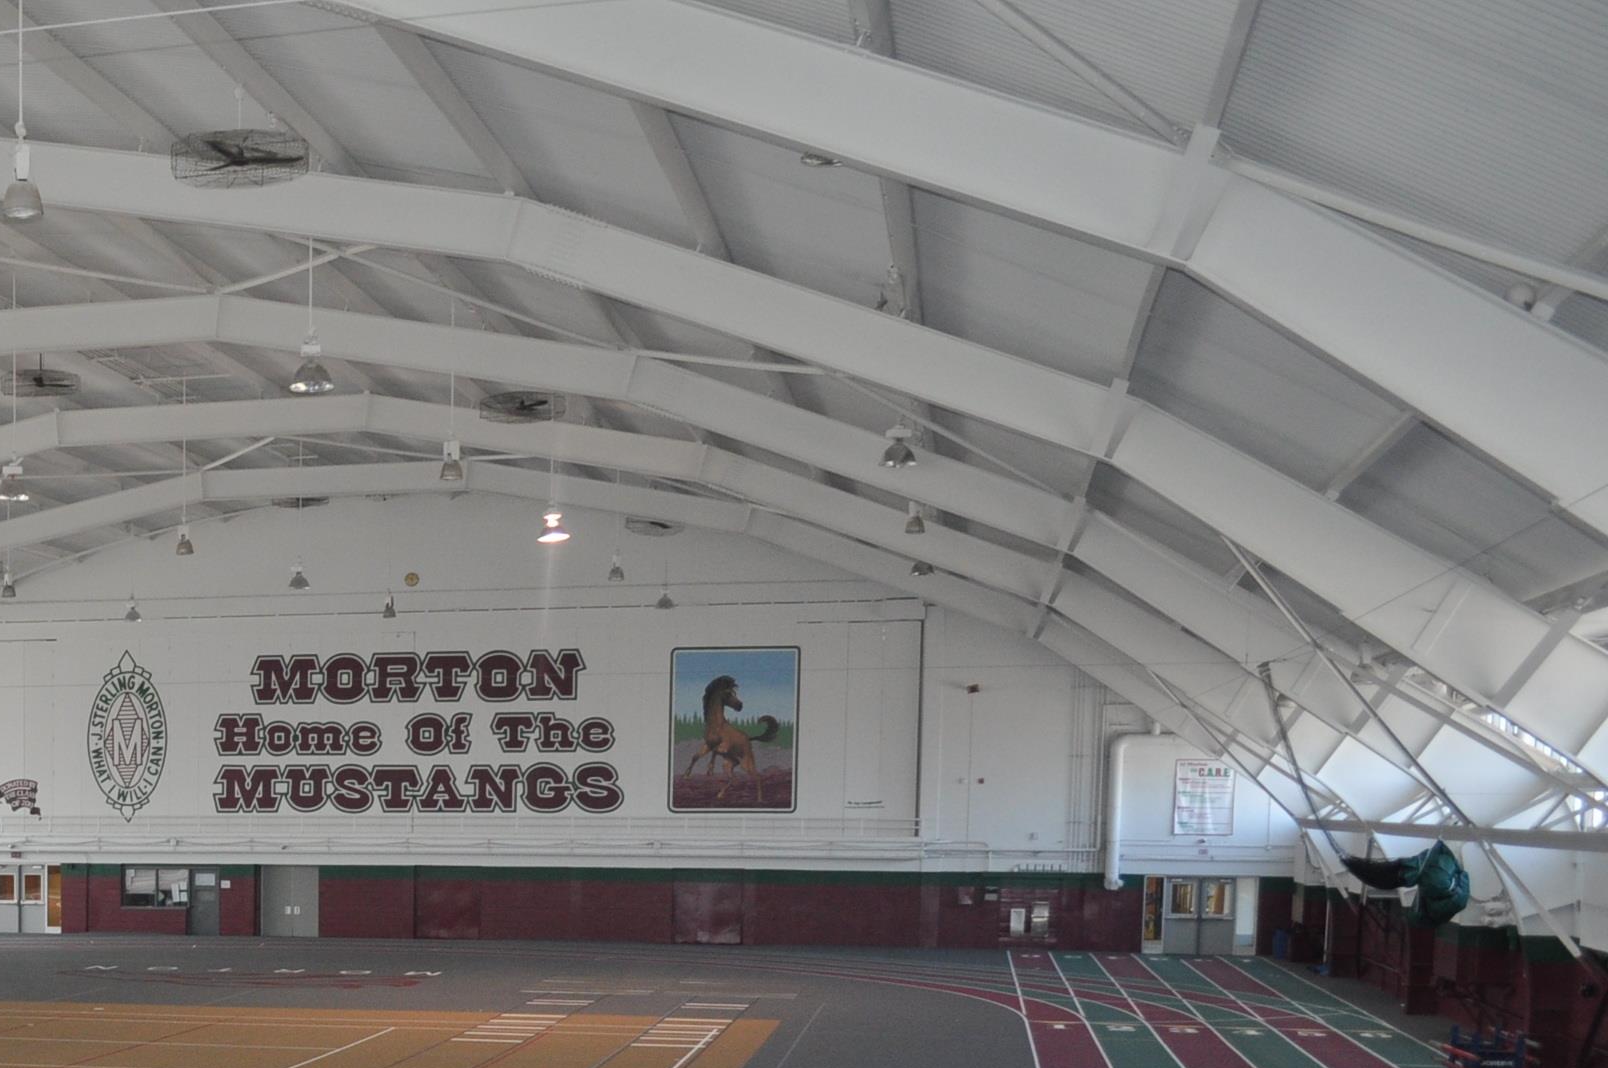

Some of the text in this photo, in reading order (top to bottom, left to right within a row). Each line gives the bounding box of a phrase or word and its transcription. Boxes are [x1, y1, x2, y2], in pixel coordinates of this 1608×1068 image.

[251, 650, 585, 703] MORTON
[136, 680, 163, 740] MORTON
[215, 713, 614, 755] Home Of The
[1, 781, 28, 791] DONATED
[92, 747, 111, 783] WHAT
[117, 784, 147, 803] WILL
[147, 746, 163, 777] CAN
[214, 763, 624, 812] MUSTANGS
